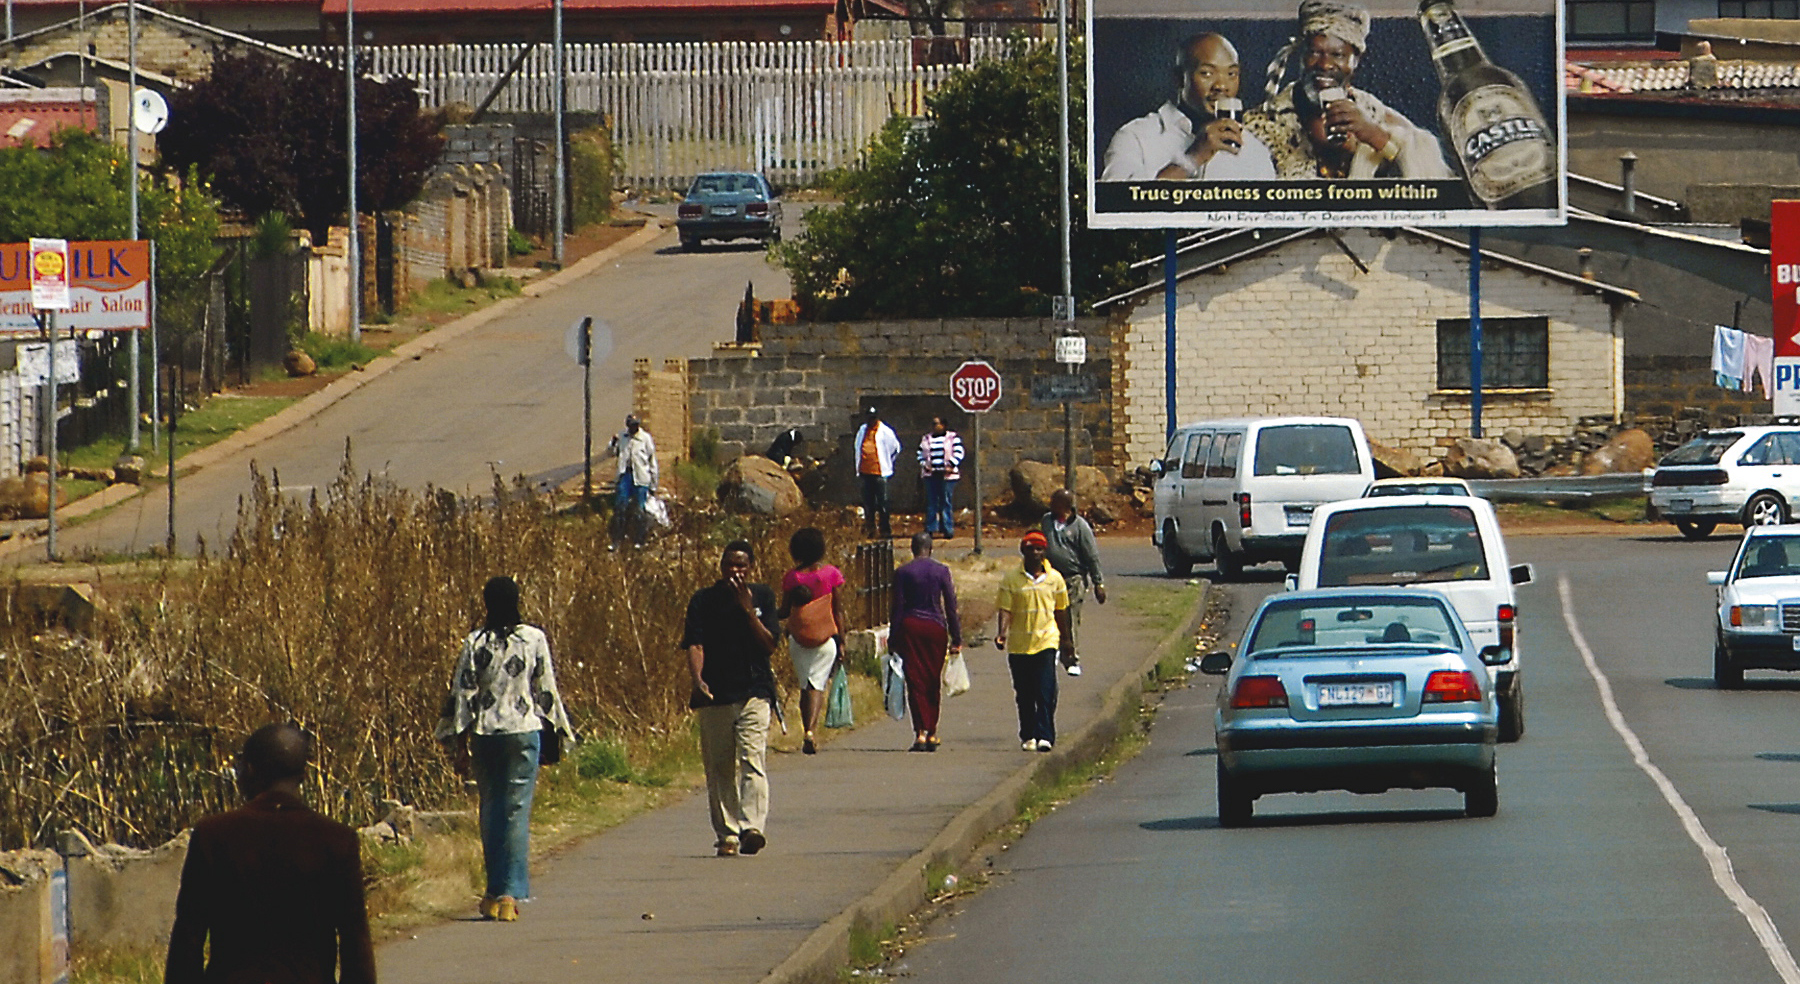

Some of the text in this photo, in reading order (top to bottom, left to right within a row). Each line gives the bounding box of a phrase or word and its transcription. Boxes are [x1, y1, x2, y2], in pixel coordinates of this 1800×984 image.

[1467, 119, 1541, 155] CASTLE
[1129, 184, 1438, 205] True greatness comes from within
[101, 294, 143, 313] Salon
[956, 377, 996, 398] STOP
